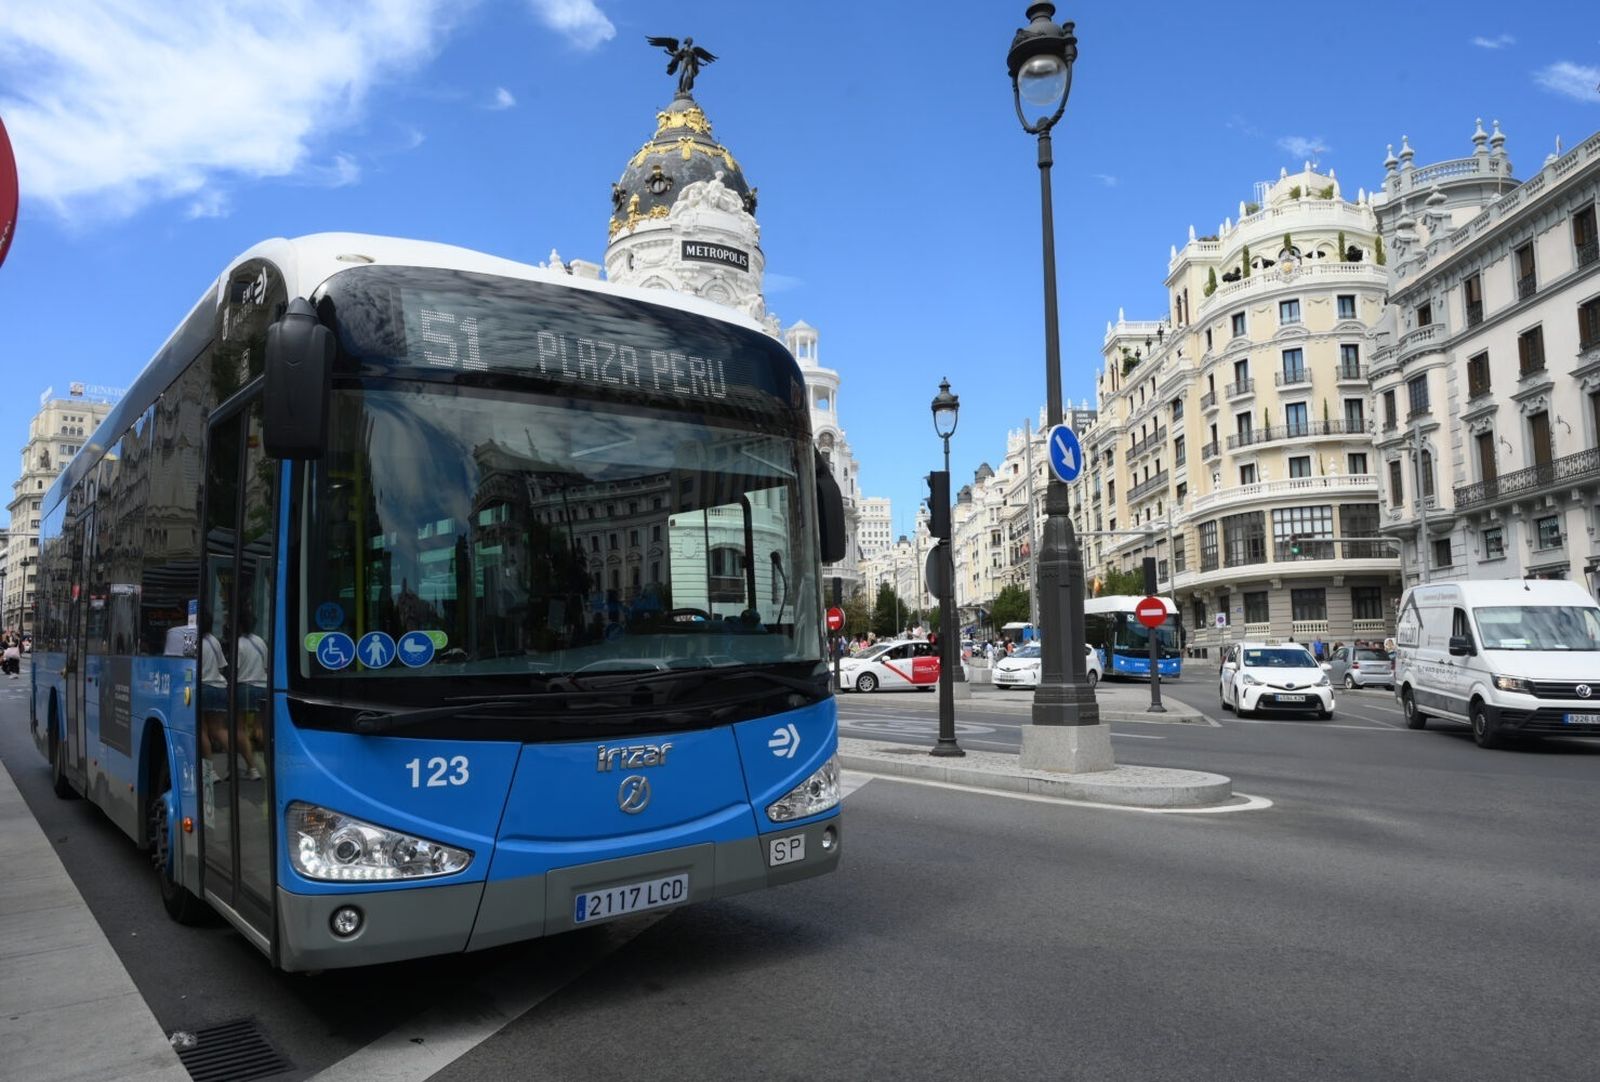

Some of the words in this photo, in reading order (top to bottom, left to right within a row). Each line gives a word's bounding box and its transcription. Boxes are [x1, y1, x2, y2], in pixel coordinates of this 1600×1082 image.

[686, 244, 748, 267] METROPOLIS
[420, 308, 490, 373] 51
[537, 329, 641, 388] PLAZA
[651, 349, 728, 400] PERU
[405, 755, 470, 788] 123
[596, 743, 673, 773] irizar
[589, 887, 641, 917] 2117
[647, 878, 683, 905] LCD
